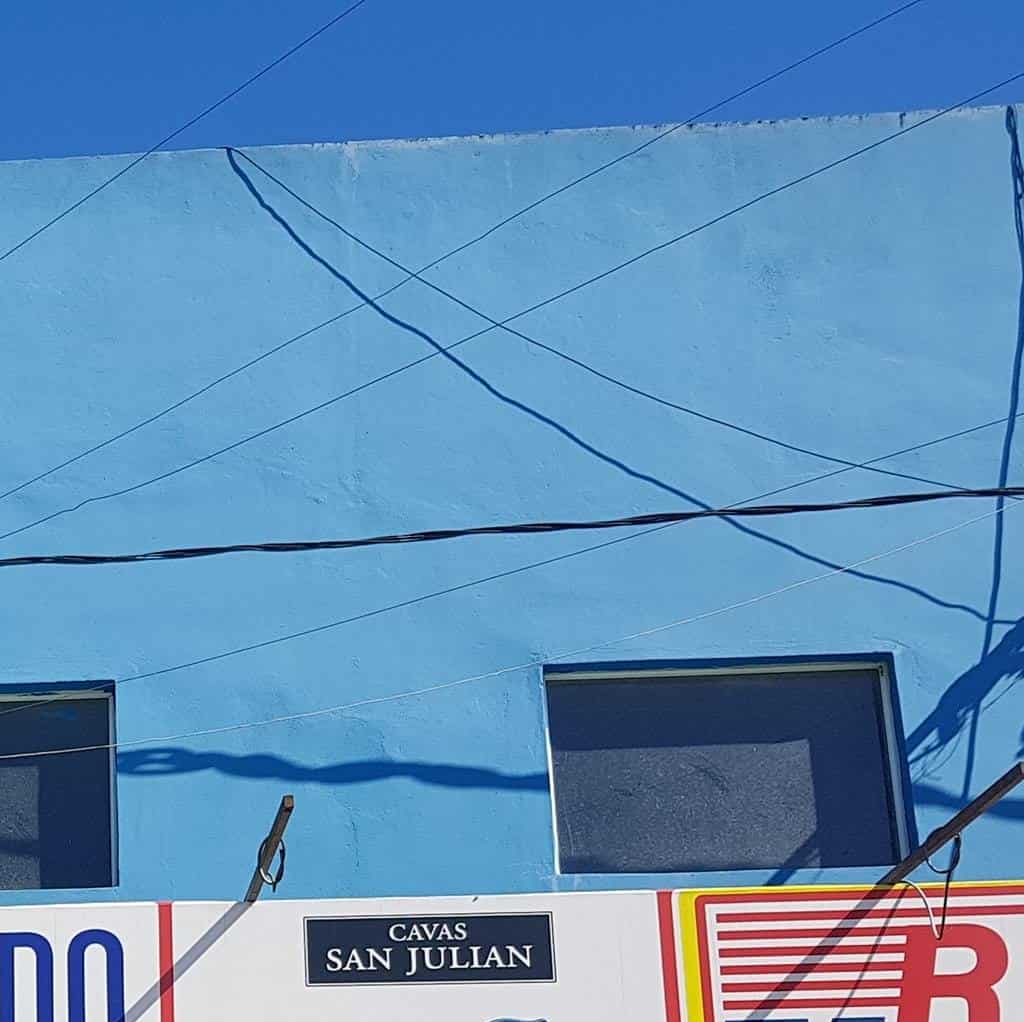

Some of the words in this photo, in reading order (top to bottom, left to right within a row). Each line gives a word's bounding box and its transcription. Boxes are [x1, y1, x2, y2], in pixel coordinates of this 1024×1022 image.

[388, 922, 468, 943] CAVAS
[326, 947, 392, 972] SAN
[406, 944, 533, 976] JULIAN
